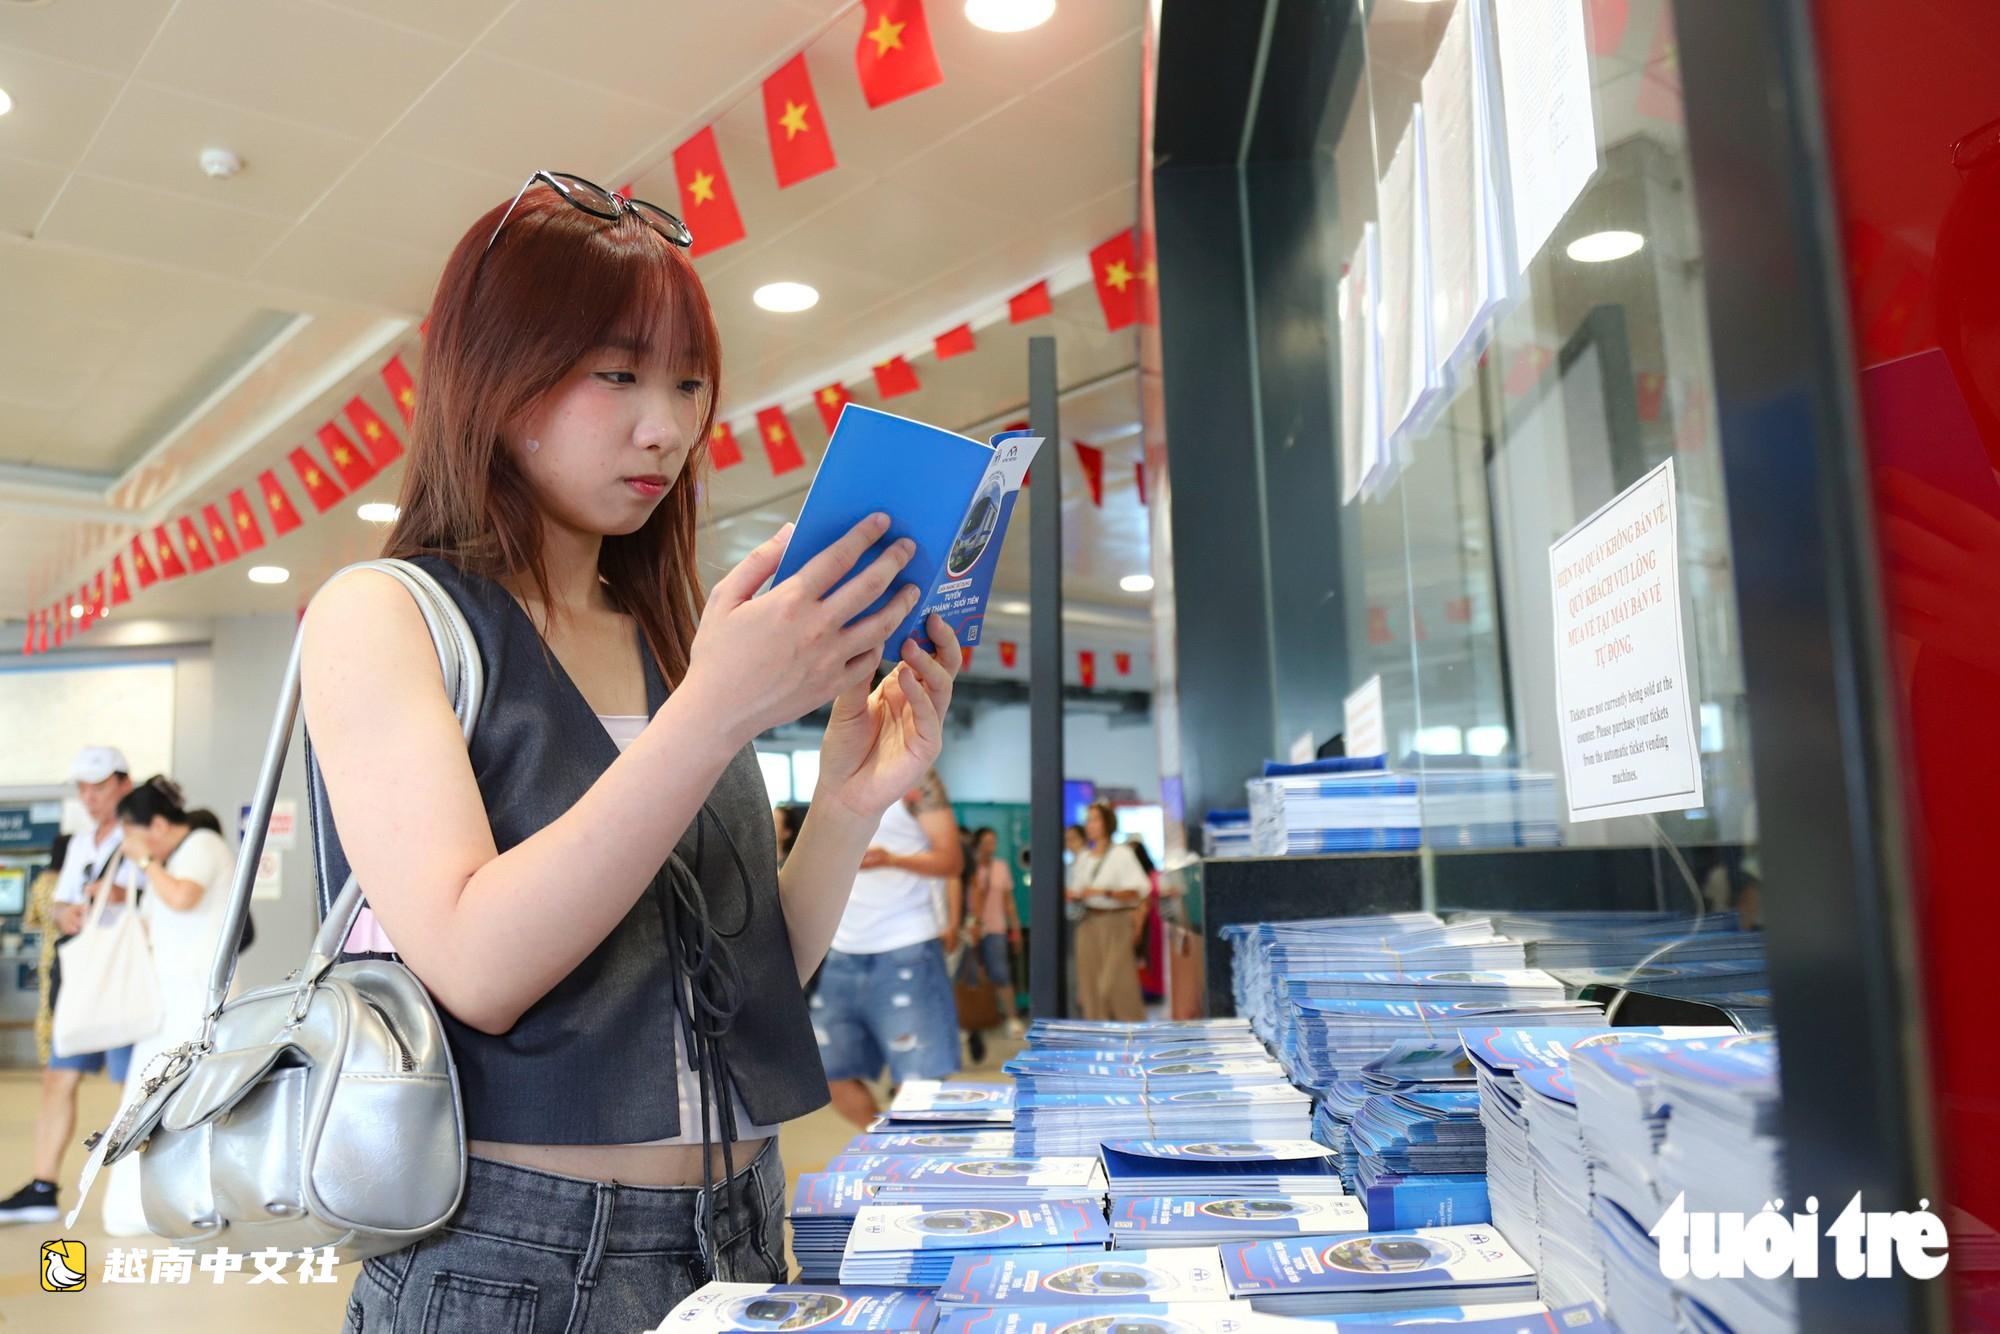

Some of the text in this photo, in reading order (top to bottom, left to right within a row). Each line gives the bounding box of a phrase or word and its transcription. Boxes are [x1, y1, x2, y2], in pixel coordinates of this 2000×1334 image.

[1614, 565, 1629, 589] VUI
[1568, 626, 1584, 648] MUA
[1650, 577, 1662, 605] VÉ
[1569, 708, 1586, 722] Tickets
[1604, 692, 1628, 710] currently
[1628, 688, 1643, 704] being
[1643, 680, 1656, 698] sold
[1663, 675, 1673, 690] the
[1596, 724, 1612, 739] Please
[1612, 717, 1636, 738] purchase
[1636, 713, 1649, 732] your
[1649, 705, 1669, 723] tickets
[1583, 752, 1595, 767] from
[1603, 744, 1629, 762] automatic
[1629, 739, 1645, 755] ticket
[1645, 734, 1669, 752] vending
